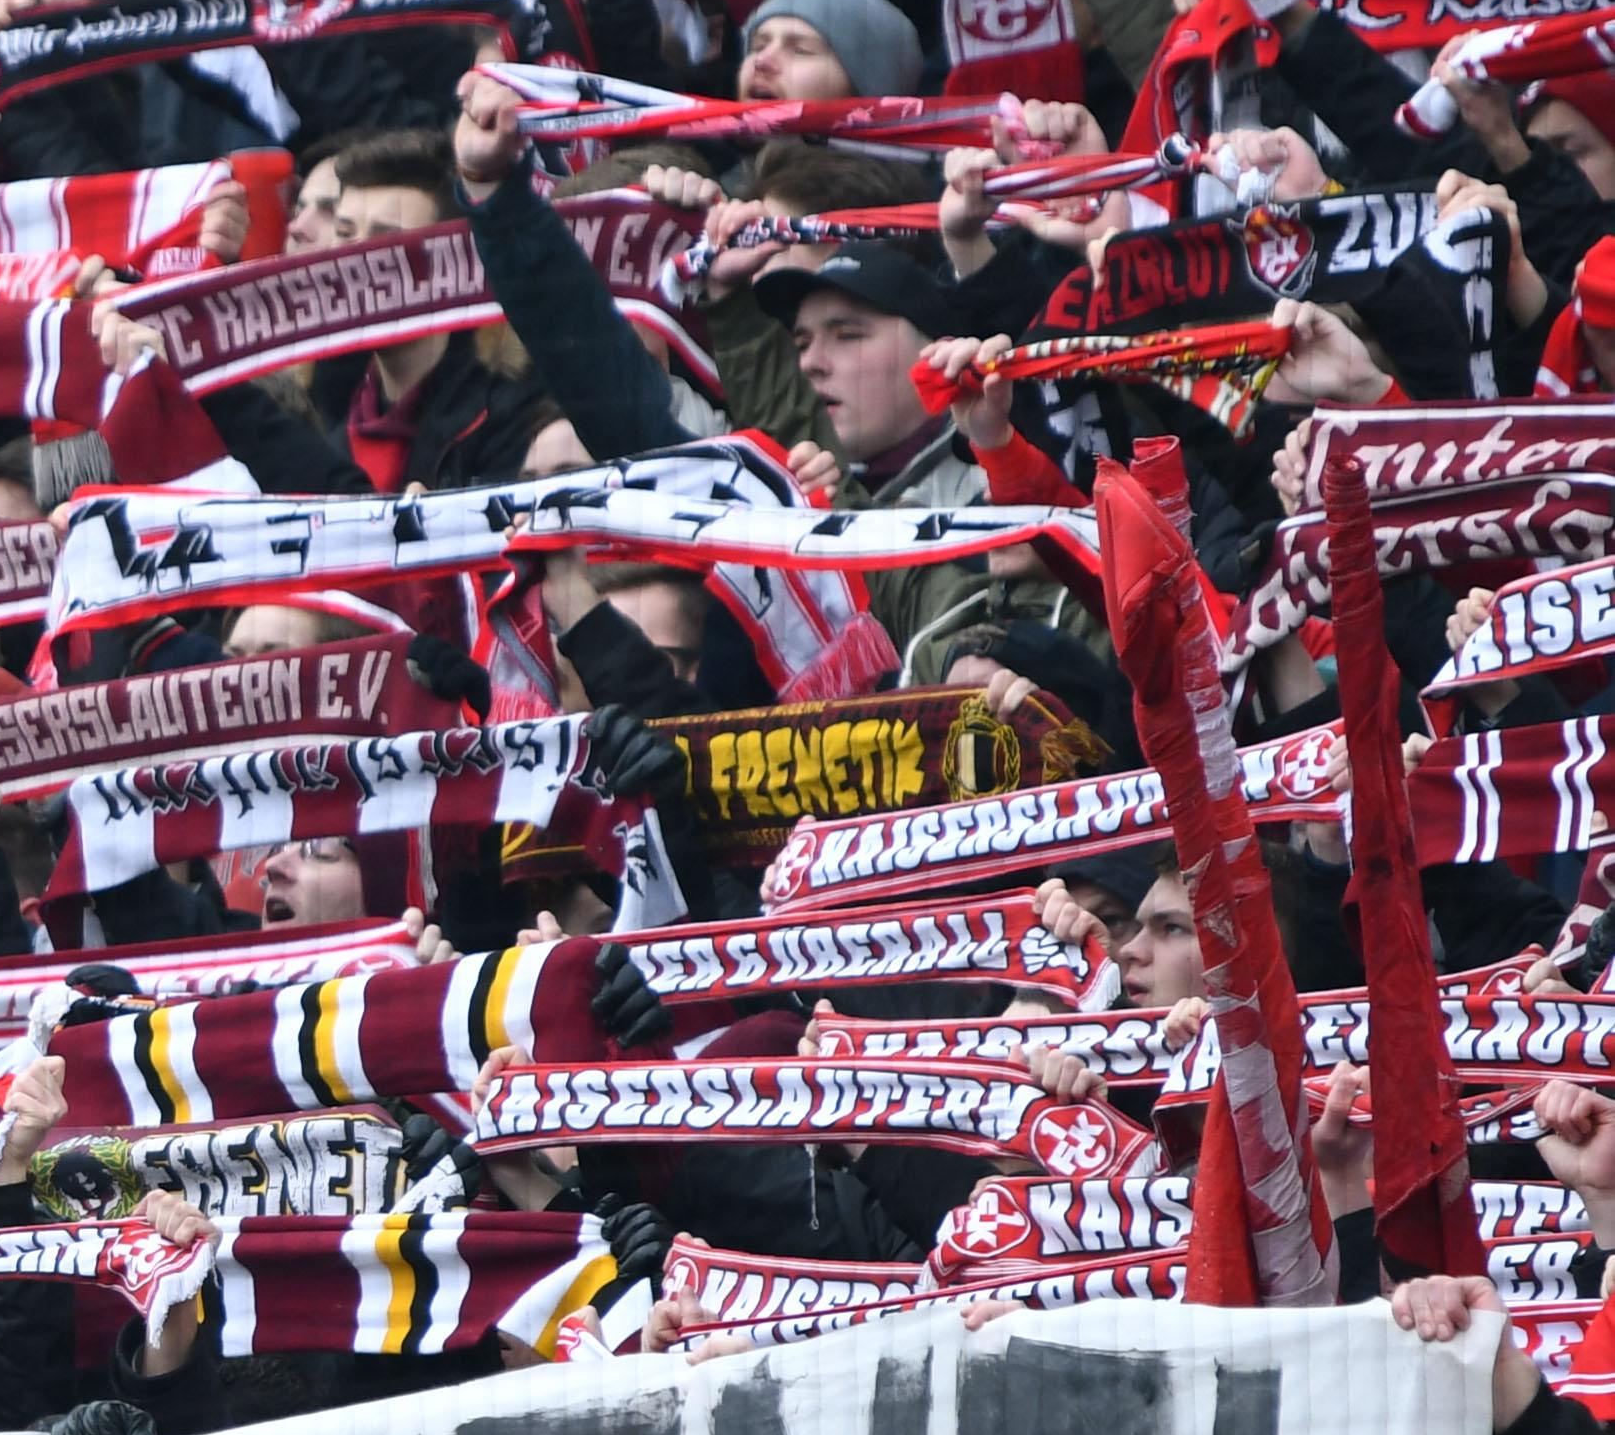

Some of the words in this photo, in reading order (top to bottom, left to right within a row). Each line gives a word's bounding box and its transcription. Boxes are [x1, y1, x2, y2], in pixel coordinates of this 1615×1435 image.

[1041, 219, 1235, 334] ERZBLUT
[313, 648, 392, 726] E.V.
[706, 717, 925, 821] FRENETIK
